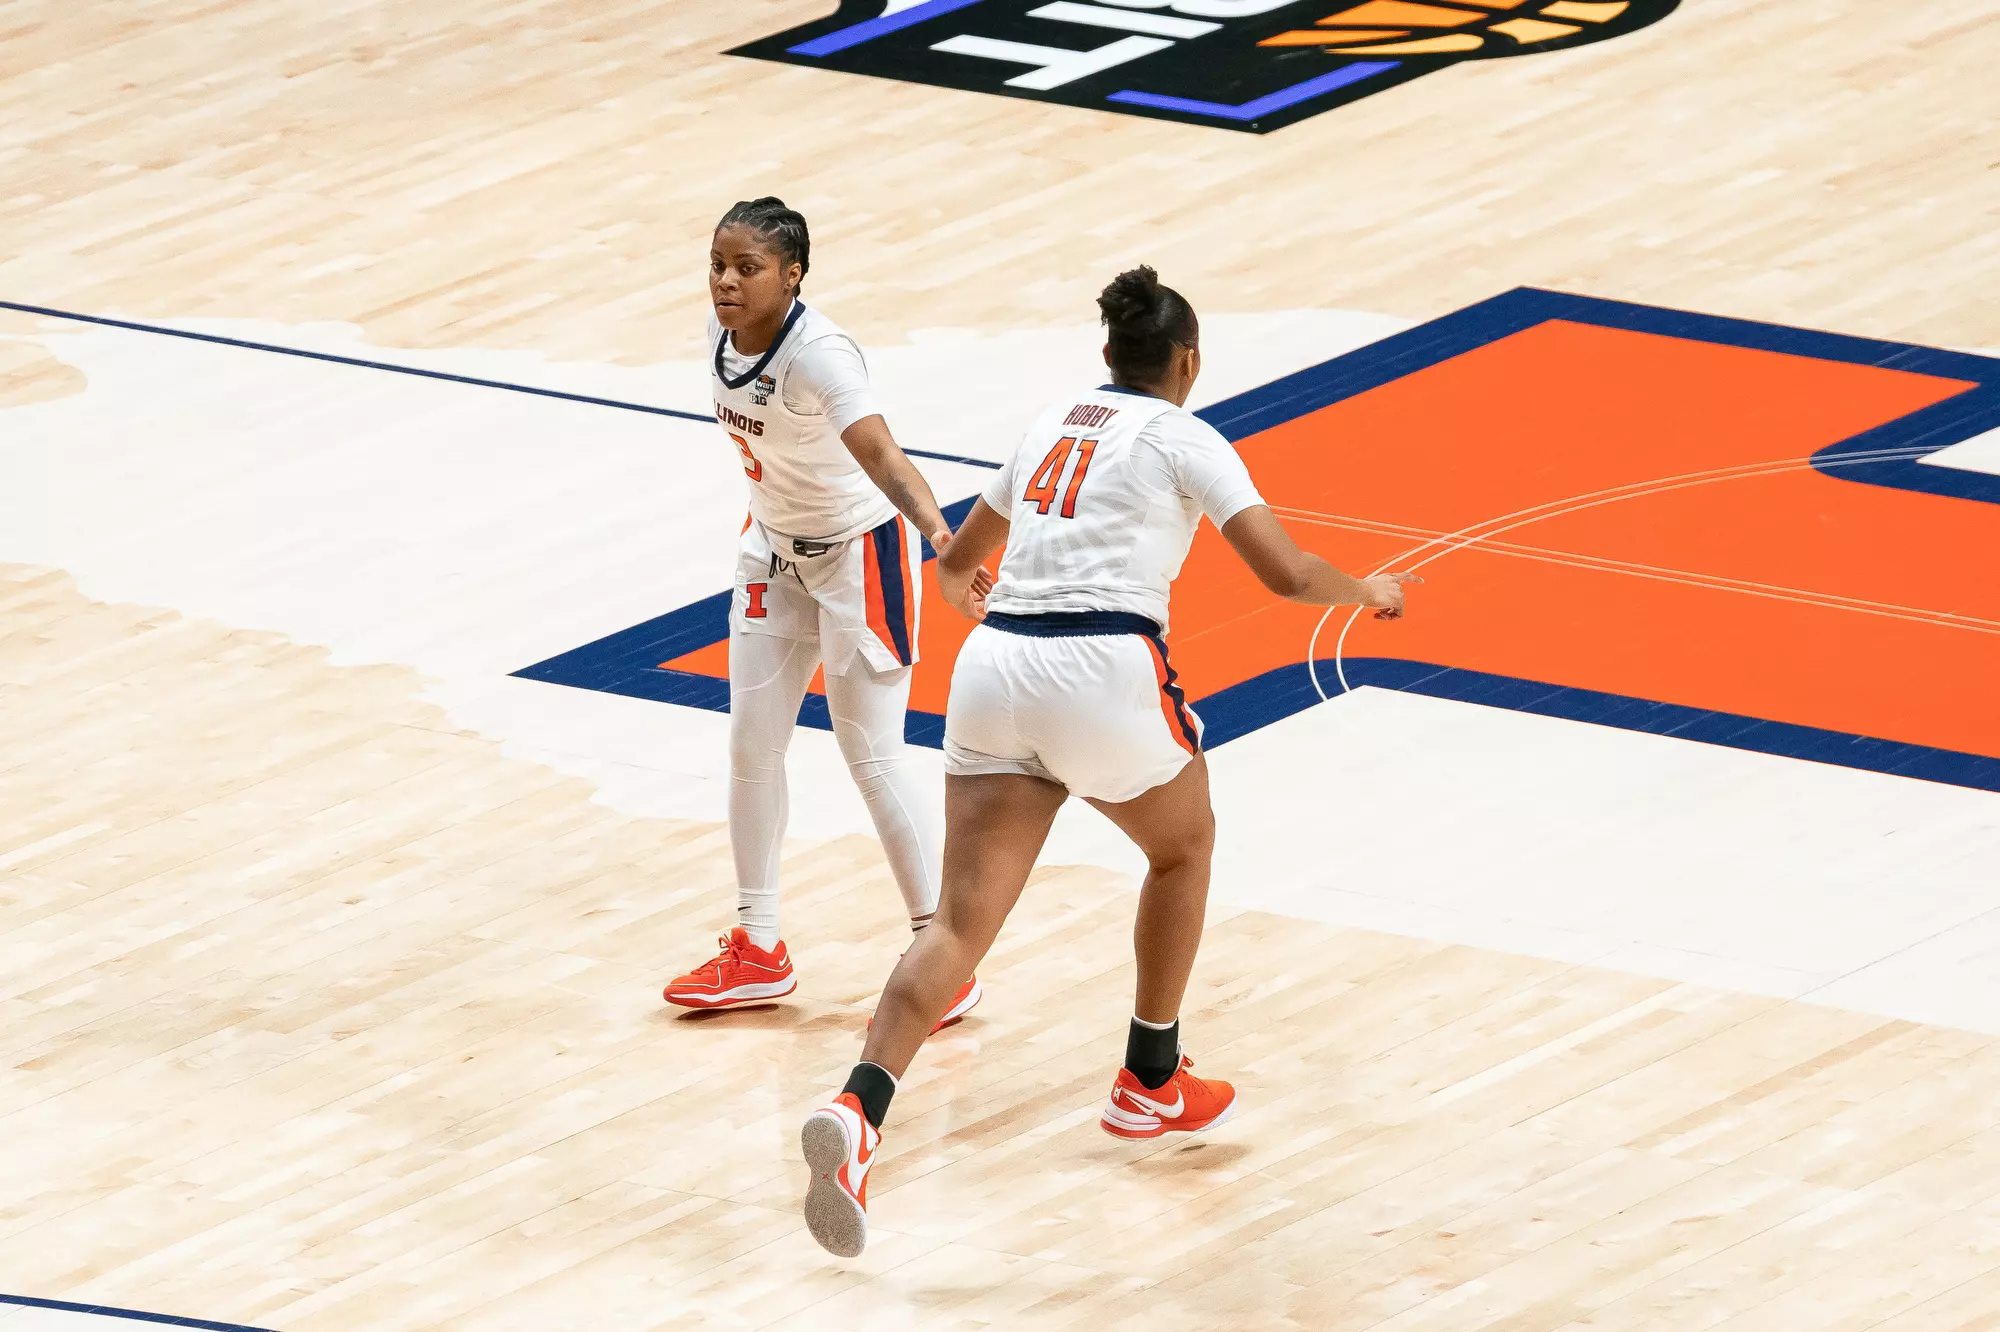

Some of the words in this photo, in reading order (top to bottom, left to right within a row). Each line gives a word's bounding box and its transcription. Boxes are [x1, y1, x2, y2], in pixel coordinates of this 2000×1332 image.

[1062, 404, 1120, 429] HOBBY
[1022, 436, 1099, 519] 41
[745, 583, 767, 618] I
